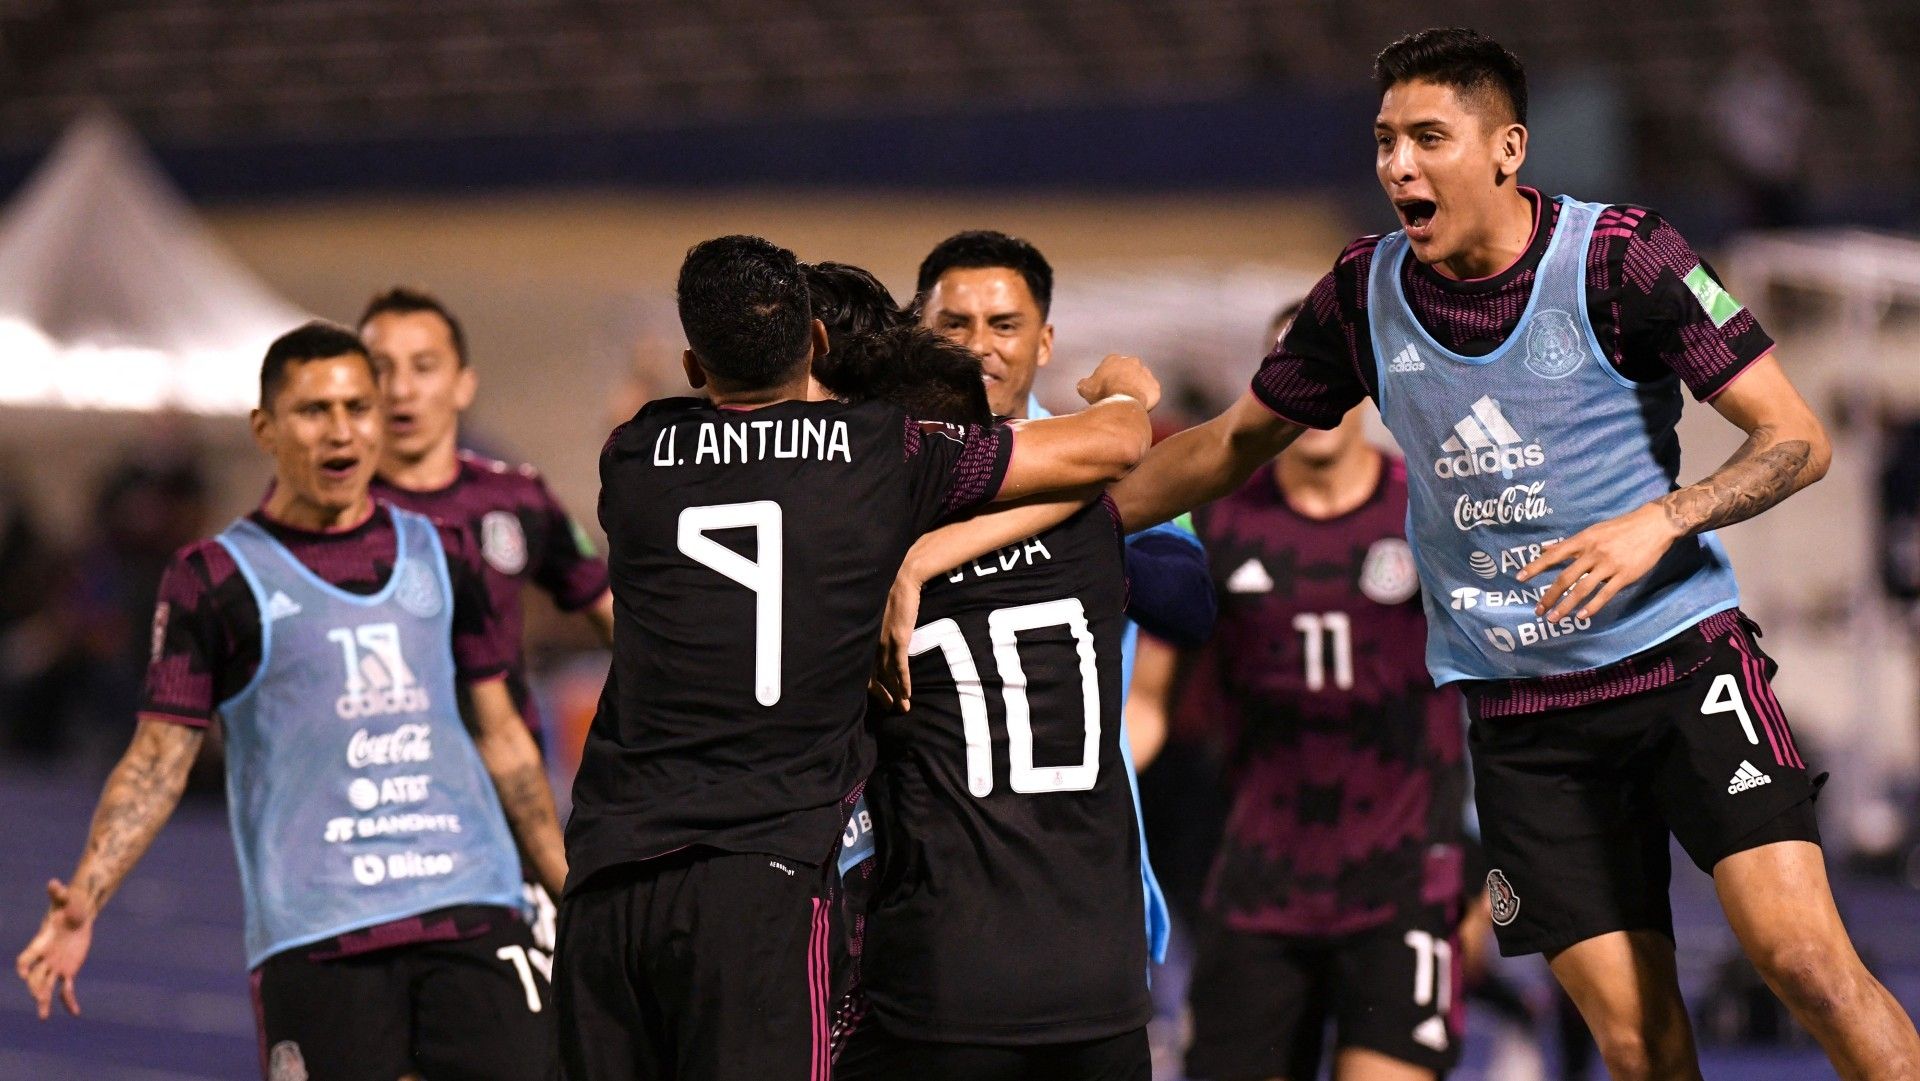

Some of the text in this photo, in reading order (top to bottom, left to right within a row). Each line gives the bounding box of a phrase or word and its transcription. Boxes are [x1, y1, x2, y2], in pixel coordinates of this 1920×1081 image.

[1389, 361, 1426, 373] adidas
[653, 418, 852, 467] U. ANTUNA
[1434, 440, 1545, 479] adidas
[1454, 481, 1549, 531] Coca-Cola
[677, 500, 782, 706] 9
[1292, 611, 1354, 692] 11
[908, 598, 1101, 798] 10
[1700, 673, 1759, 745] 4
[1728, 775, 1771, 795] adidas
